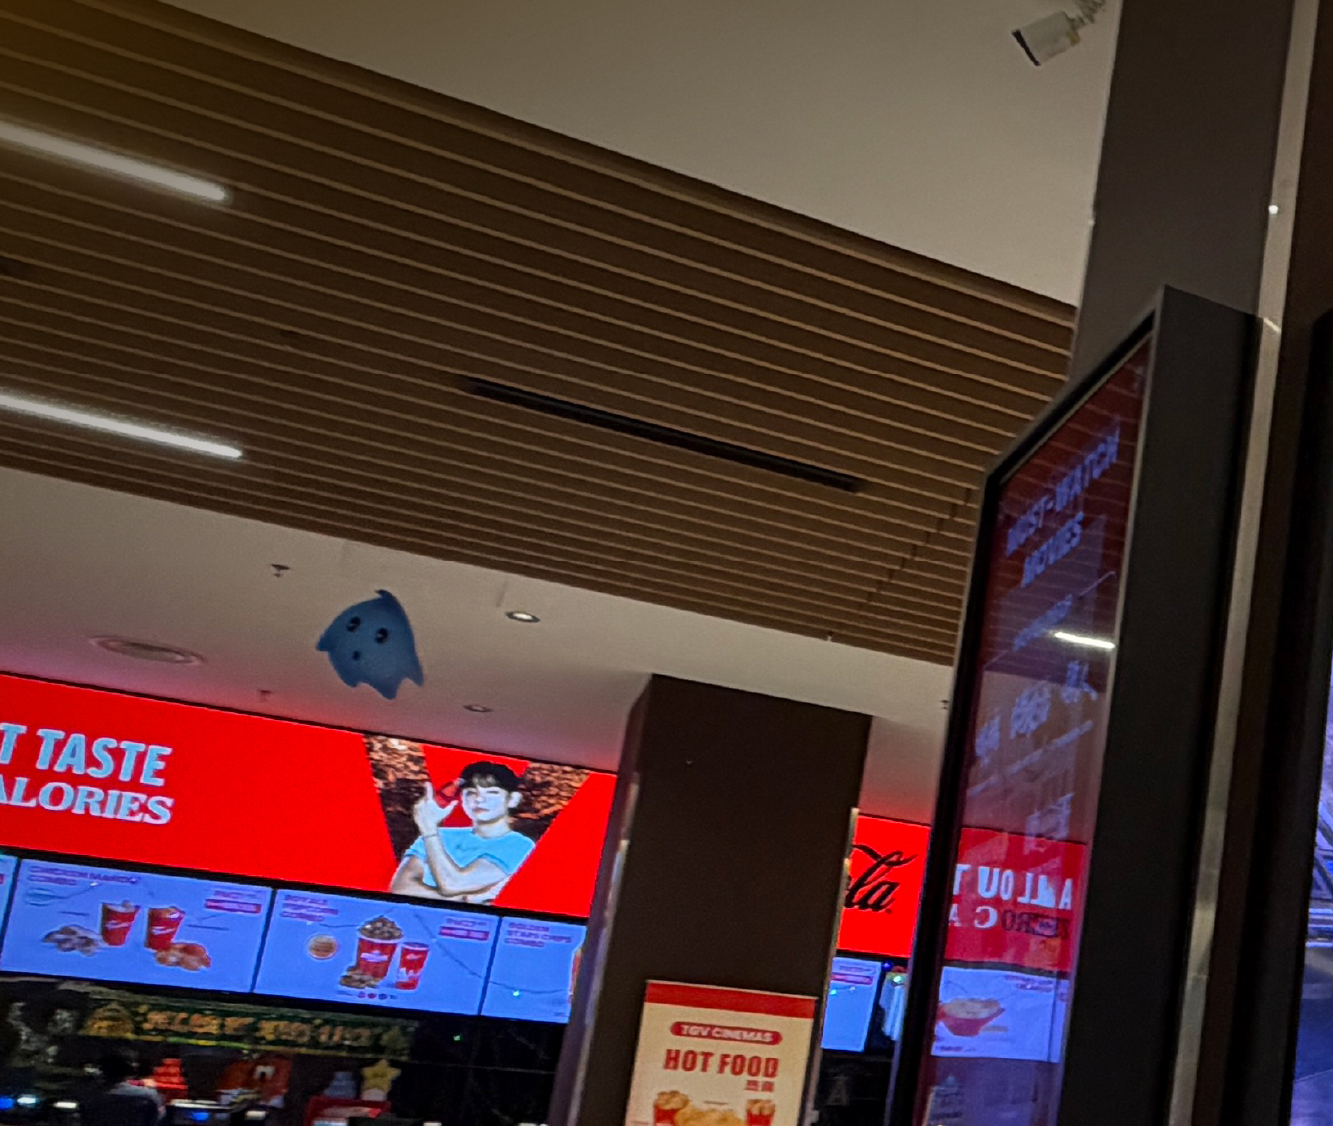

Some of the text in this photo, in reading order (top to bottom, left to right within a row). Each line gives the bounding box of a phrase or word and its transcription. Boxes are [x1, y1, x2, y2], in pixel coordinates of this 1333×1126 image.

[36, 728, 173, 787] TASTE
[681, 1024, 774, 1043] TGV CINEMAS
[664, 1049, 779, 1078] HOT FOOD
